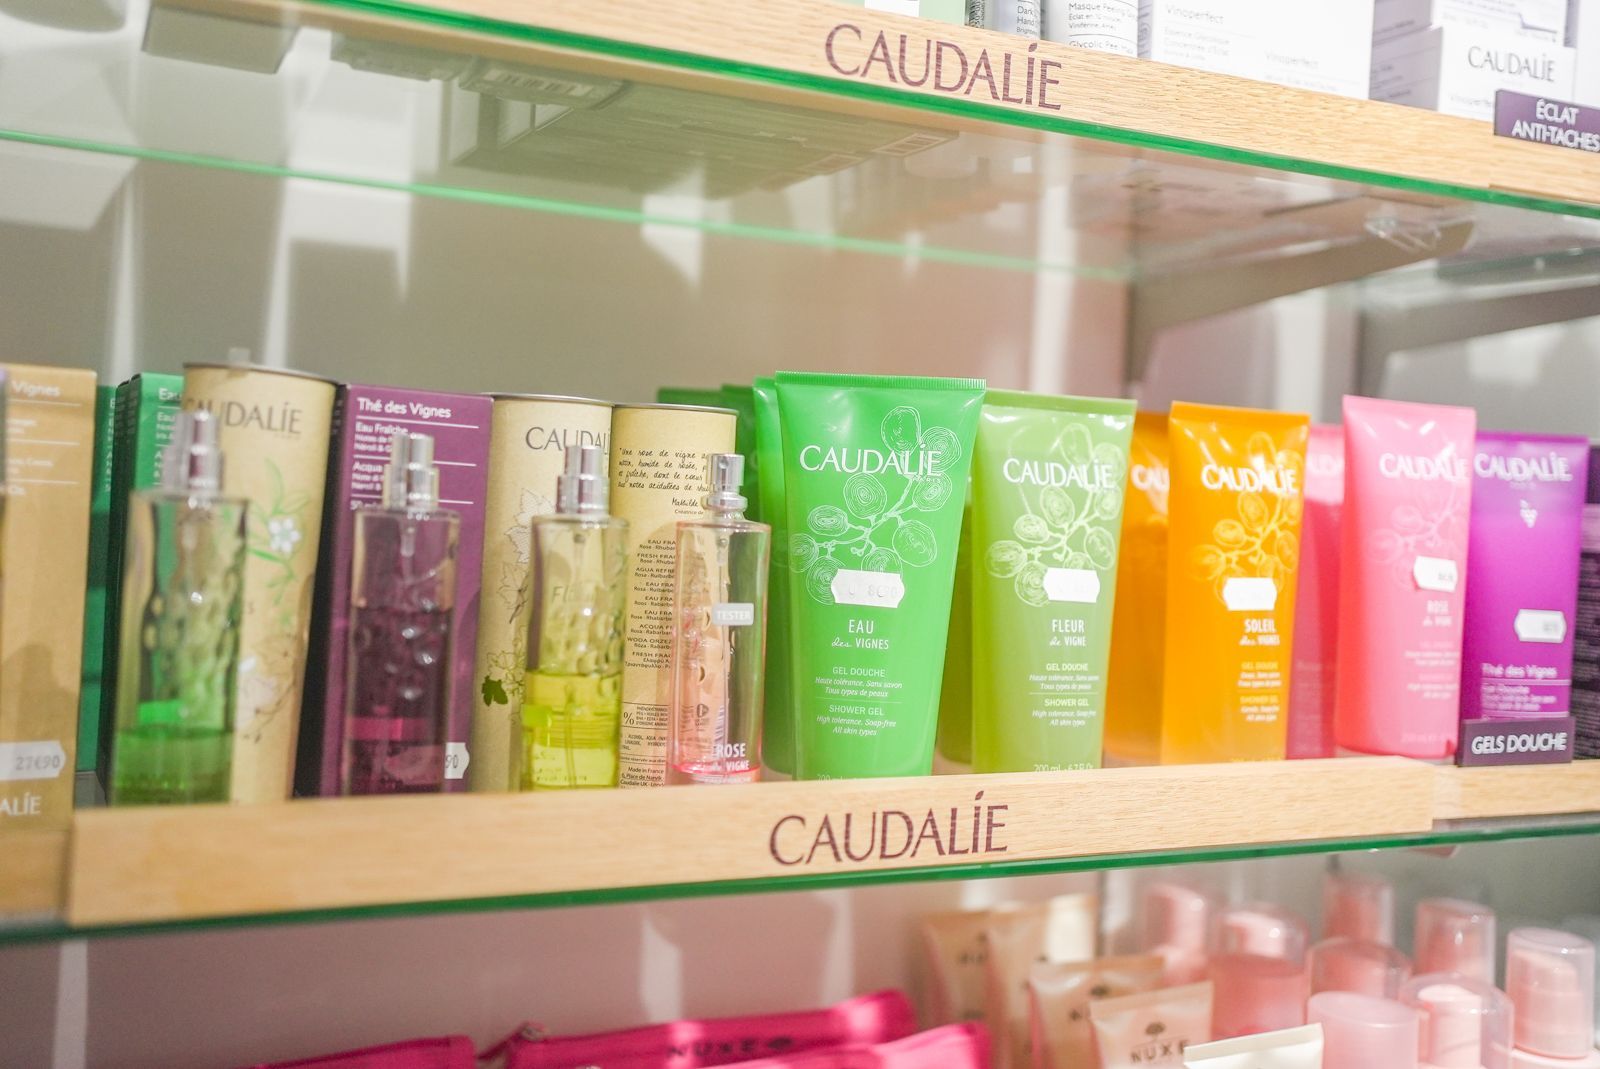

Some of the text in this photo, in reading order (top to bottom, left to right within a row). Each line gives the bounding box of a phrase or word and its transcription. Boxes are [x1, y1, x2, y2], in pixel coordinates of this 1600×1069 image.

[1535, 98, 1580, 126] ÉCLAT
[1511, 119, 1600, 152] ANTI-TACHES
[357, 397, 452, 419] Thé des Vignes
[659, 449, 669, 457] de
[675, 452, 696, 463] vigne
[717, 610, 753, 621] TESTER
[848, 619, 875, 634] EAU
[1051, 619, 1085, 633] FLEUR
[1244, 618, 1277, 633] SOLEIL
[831, 637, 890, 649] des VIGNES
[1064, 636, 1086, 647] VIGNE
[832, 666, 886, 677] GEL DOUCHE
[1046, 663, 1089, 671] GEL DOUCHE
[840, 688, 859, 697] types
[1044, 698, 1077, 707] SHOWER
[829, 704, 885, 716] SHOWER GEL
[1471, 732, 1567, 755] GELS DOUCHE
